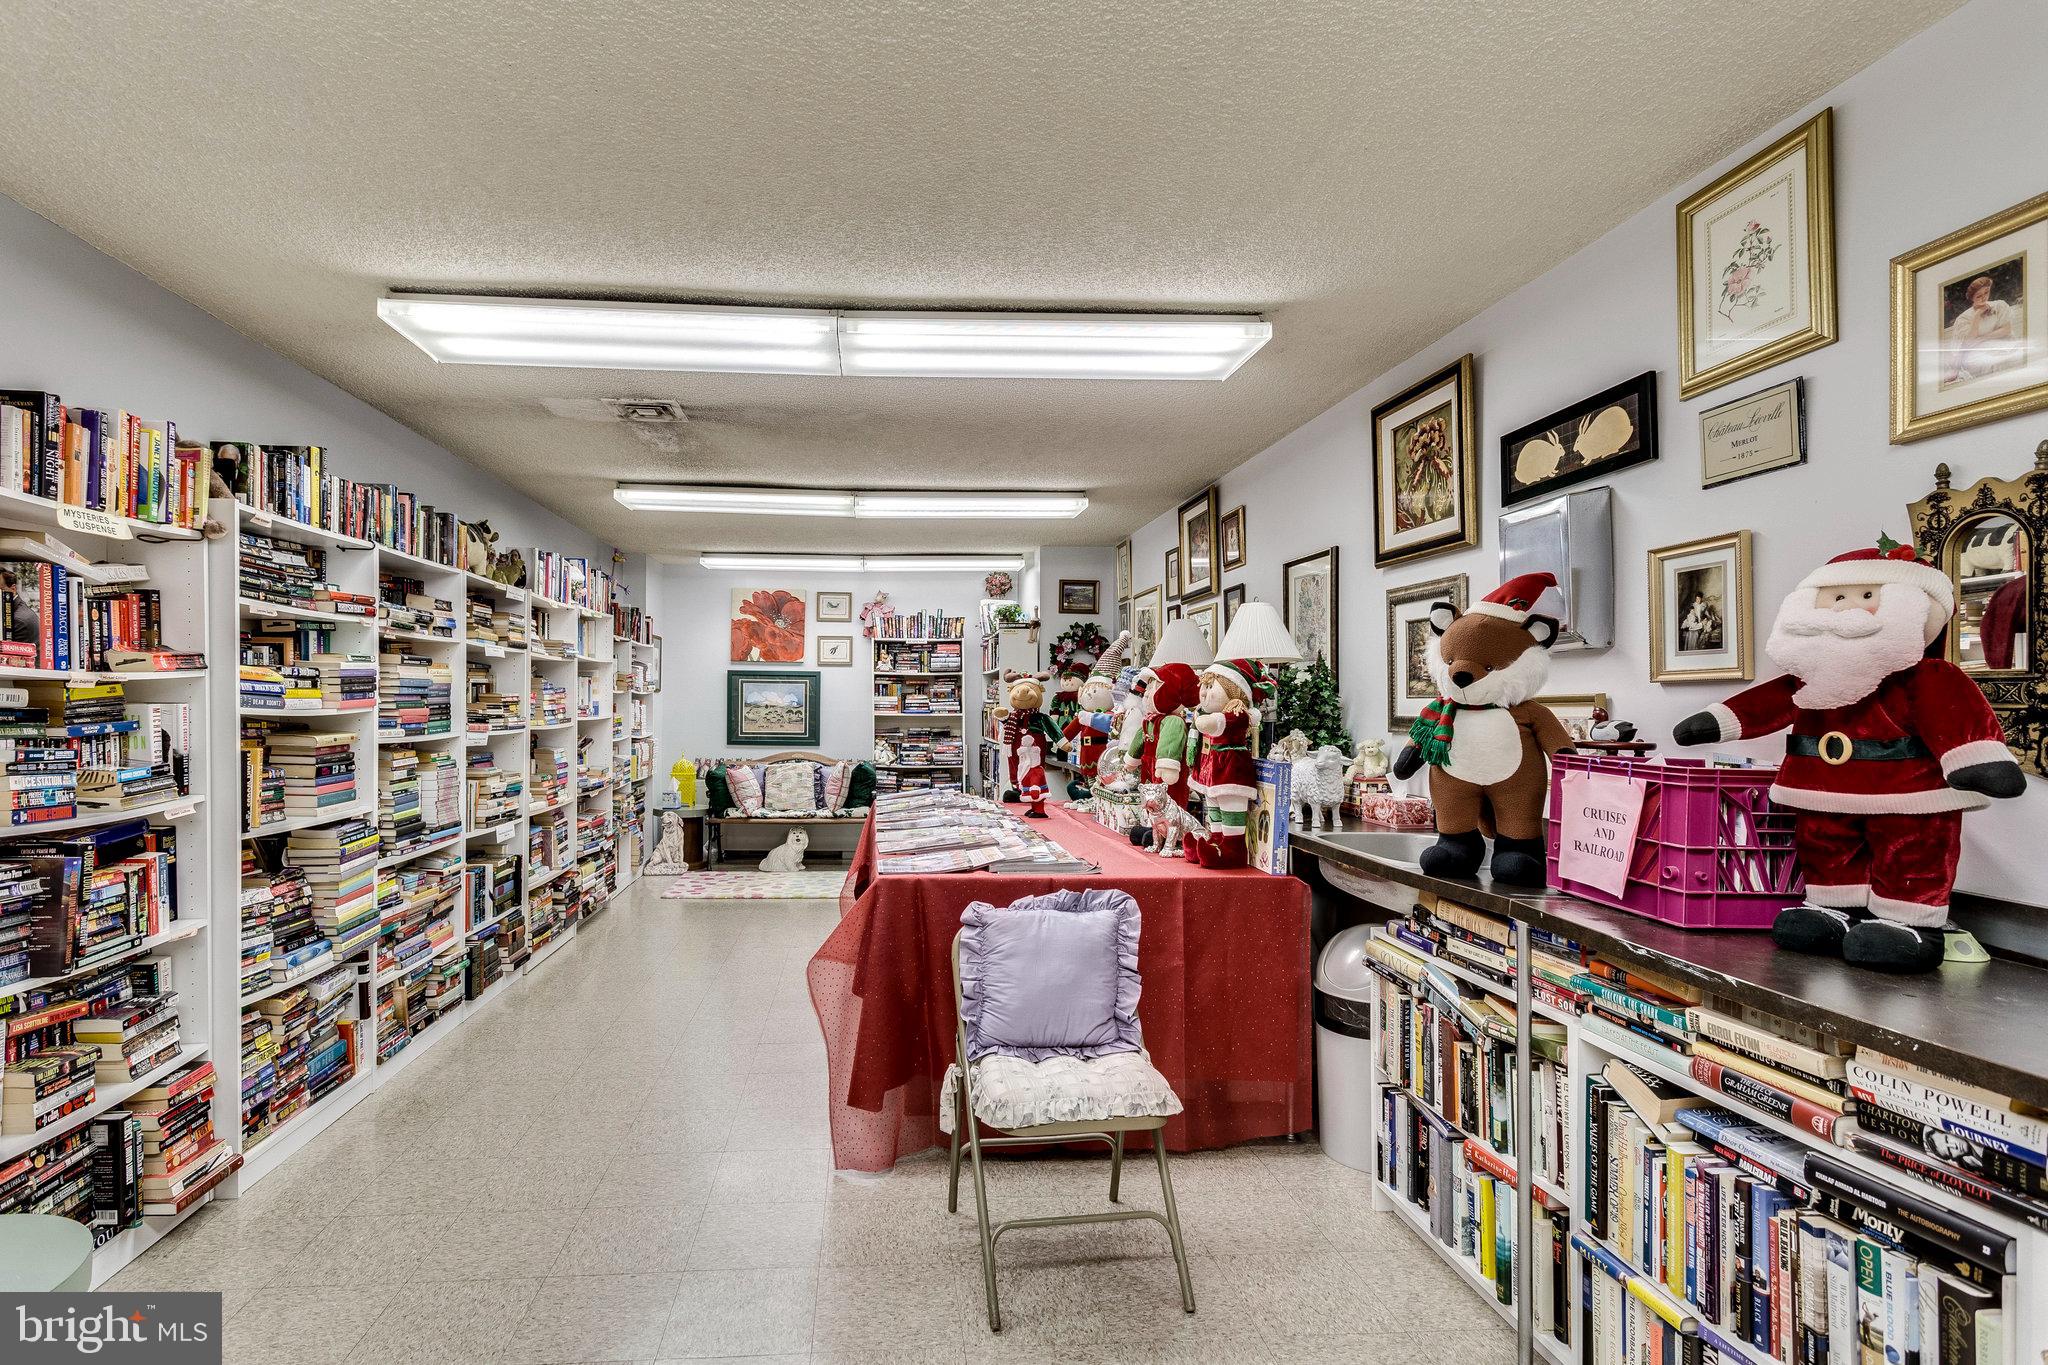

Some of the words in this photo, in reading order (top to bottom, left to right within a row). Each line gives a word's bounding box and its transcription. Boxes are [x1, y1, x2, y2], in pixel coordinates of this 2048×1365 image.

[133, 424, 141, 446] JANET
[153, 437, 161, 460] JANET
[45, 449, 55, 483] NIGHT
[132, 448, 140, 490] EVANOVICH
[152, 462, 161, 503] EVANOVICH
[63, 508, 110, 525] MYSTERIES
[73, 520, 118, 536] SUSPENSE
[43, 566, 52, 588] DAVID
[58, 569, 67, 593] DAVID
[43, 590, 52, 626] BALDACCI
[58, 594, 67, 634] ALDACCI
[93, 620, 101, 636] GREG
[93, 637, 101, 652] ILES
[266, 698, 281, 706] KOONTZ
[22, 776, 37, 788] ICE
[37, 775, 62, 786] STATION
[1583, 807, 1628, 826] CRUISES
[1594, 828, 1615, 841] AND
[83, 851, 94, 874] ROBERT
[1574, 840, 1625, 862] RAILROAD
[21, 880, 38, 890] MALICE
[82, 875, 93, 901] LUDLUM
[79, 916, 88, 946] DIRECTIVE
[1536, 989, 1556, 1004] LOST
[1558, 999, 1576, 1013] SON
[1627, 997, 1638, 1011] THE
[1639, 999, 1659, 1020] SHARK
[12, 1023, 23, 1033] LISA
[23, 1016, 49, 1029] SCOTTOLINE
[1707, 1021, 1734, 1039] ERROL
[1735, 1032, 1761, 1054] FLYNN
[1724, 1077, 1757, 1099] GRAHAM
[1757, 1089, 1789, 1113] GREENE
[1853, 1066, 1913, 1095] COLIN
[1923, 1089, 2013, 1129] POWELL
[1854, 1079, 1881, 1092] with
[1885, 1087, 1932, 1111] Joseph
[1956, 1113, 2010, 1136] Persico
[1618, 1117, 1627, 1140] David
[1856, 1090, 1875, 1102] MY
[1880, 1099, 1938, 1126] AMERICAN
[1949, 1124, 2011, 1154] JOURNEY
[1859, 1102, 1921, 1132] CHARLTON
[1860, 1114, 1920, 1145] HESTON
[1474, 1151, 1502, 1176] Katharine
[1591, 1154, 1598, 1166] OF
[1618, 1141, 1627, 1184] Halberstam
[1738, 1158, 1770, 1185] MALCOLM
[1608, 1154, 1618, 1197] SUMMER
[1881, 1148, 1896, 1161] The
[1898, 1152, 1928, 1176] PRICE
[1941, 1171, 1993, 1202] LOYALTY
[1618, 1187, 1627, 1219] October
[1780, 1217, 1789, 1236] BILLIE
[1852, 1206, 1906, 1243] Monty
[1898, 1207, 1909, 1218] THE
[1909, 1212, 1961, 1242] AUTOBIOGRAPHY
[1579, 1245, 1609, 1271] MISTY
[1780, 1237, 1789, 1254] JEAN
[1780, 1254, 1789, 1271] KING
[1859, 1245, 1874, 1289] OPEN
[1593, 1266, 1601, 1295] GOLD
[1830, 1275, 1838, 1292] Still
[1885, 1271, 1893, 1301] BLUE
[1628, 1295, 1636, 1313] THE
[1840, 1284, 1848, 1306] When
[1593, 1296, 1601, 1334] DIGGER
[1609, 1309, 1616, 1320] UP
[1830, 1294, 1840, 1329] Mattered
[1840, 1307, 1848, 1331] Pride
[1885, 1303, 1895, 1341] BLOOD
